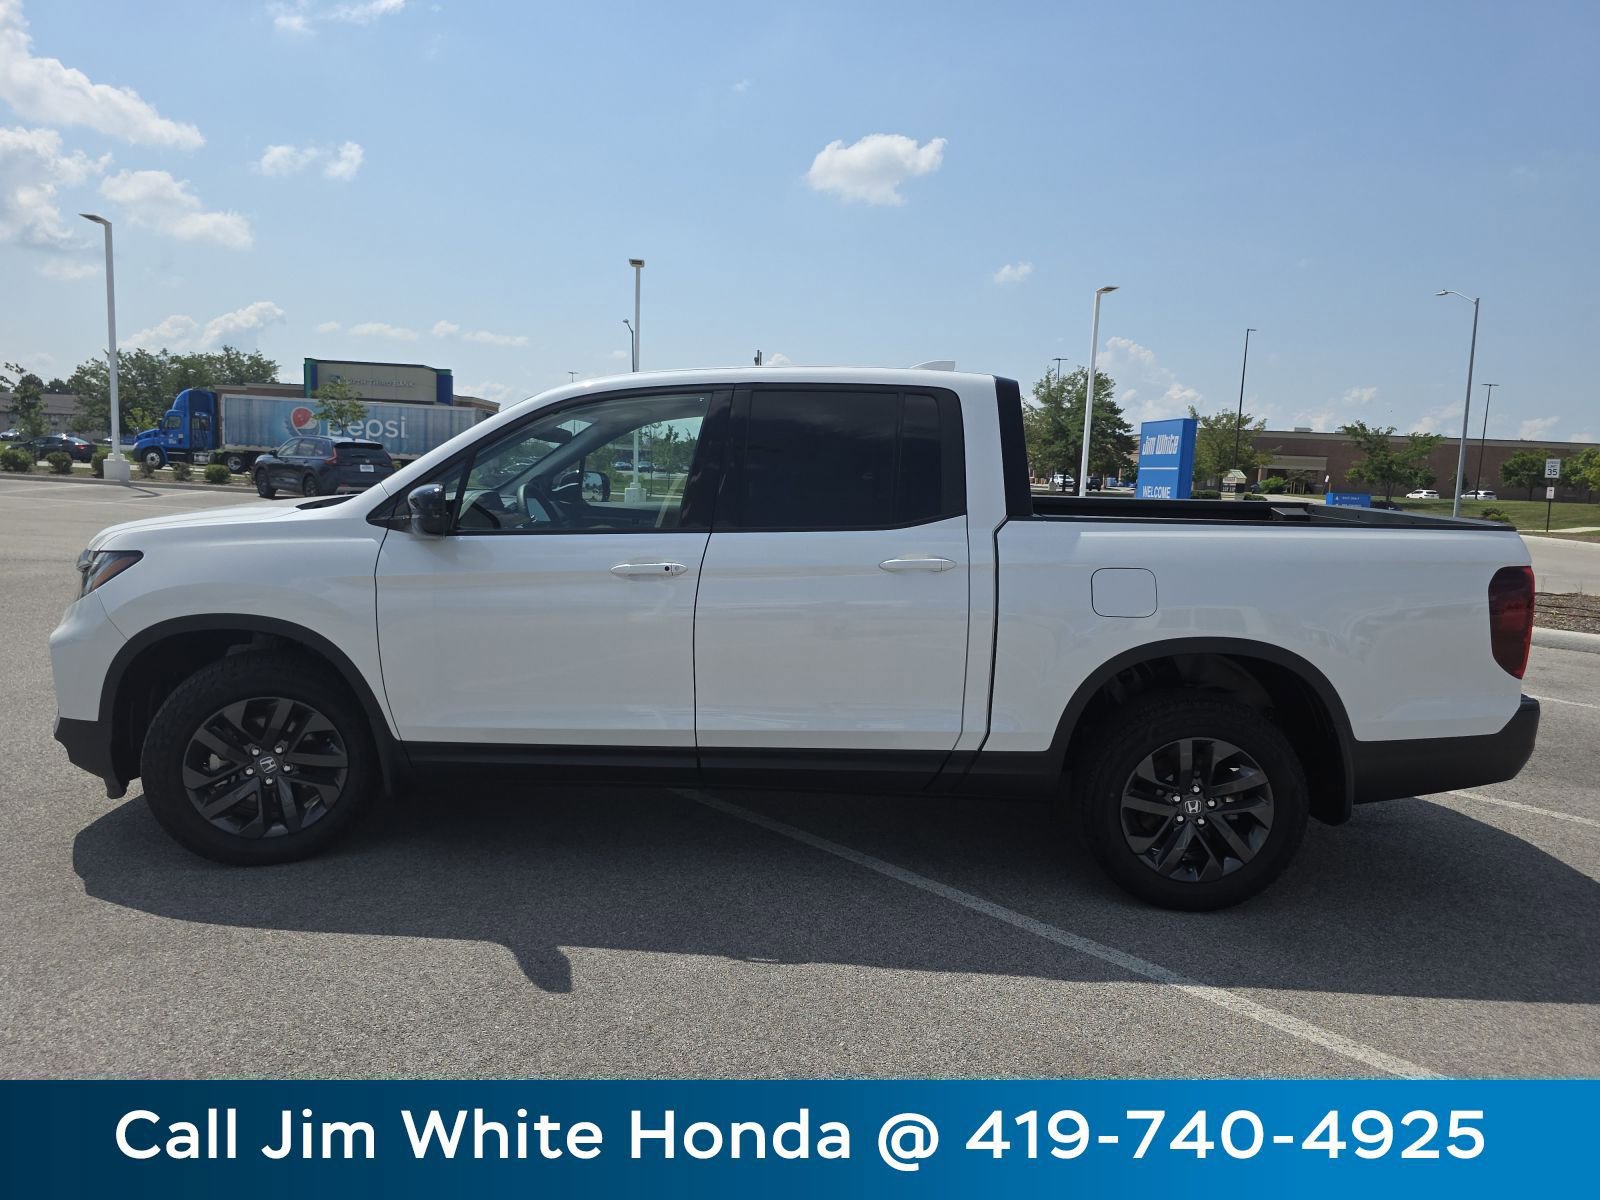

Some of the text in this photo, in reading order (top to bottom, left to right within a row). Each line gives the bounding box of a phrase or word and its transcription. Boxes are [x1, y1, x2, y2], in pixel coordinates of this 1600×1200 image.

[1142, 434, 1179, 456] Jim White
[1547, 468, 1558, 476] 35
[1142, 485, 1171, 499] WELCOME
